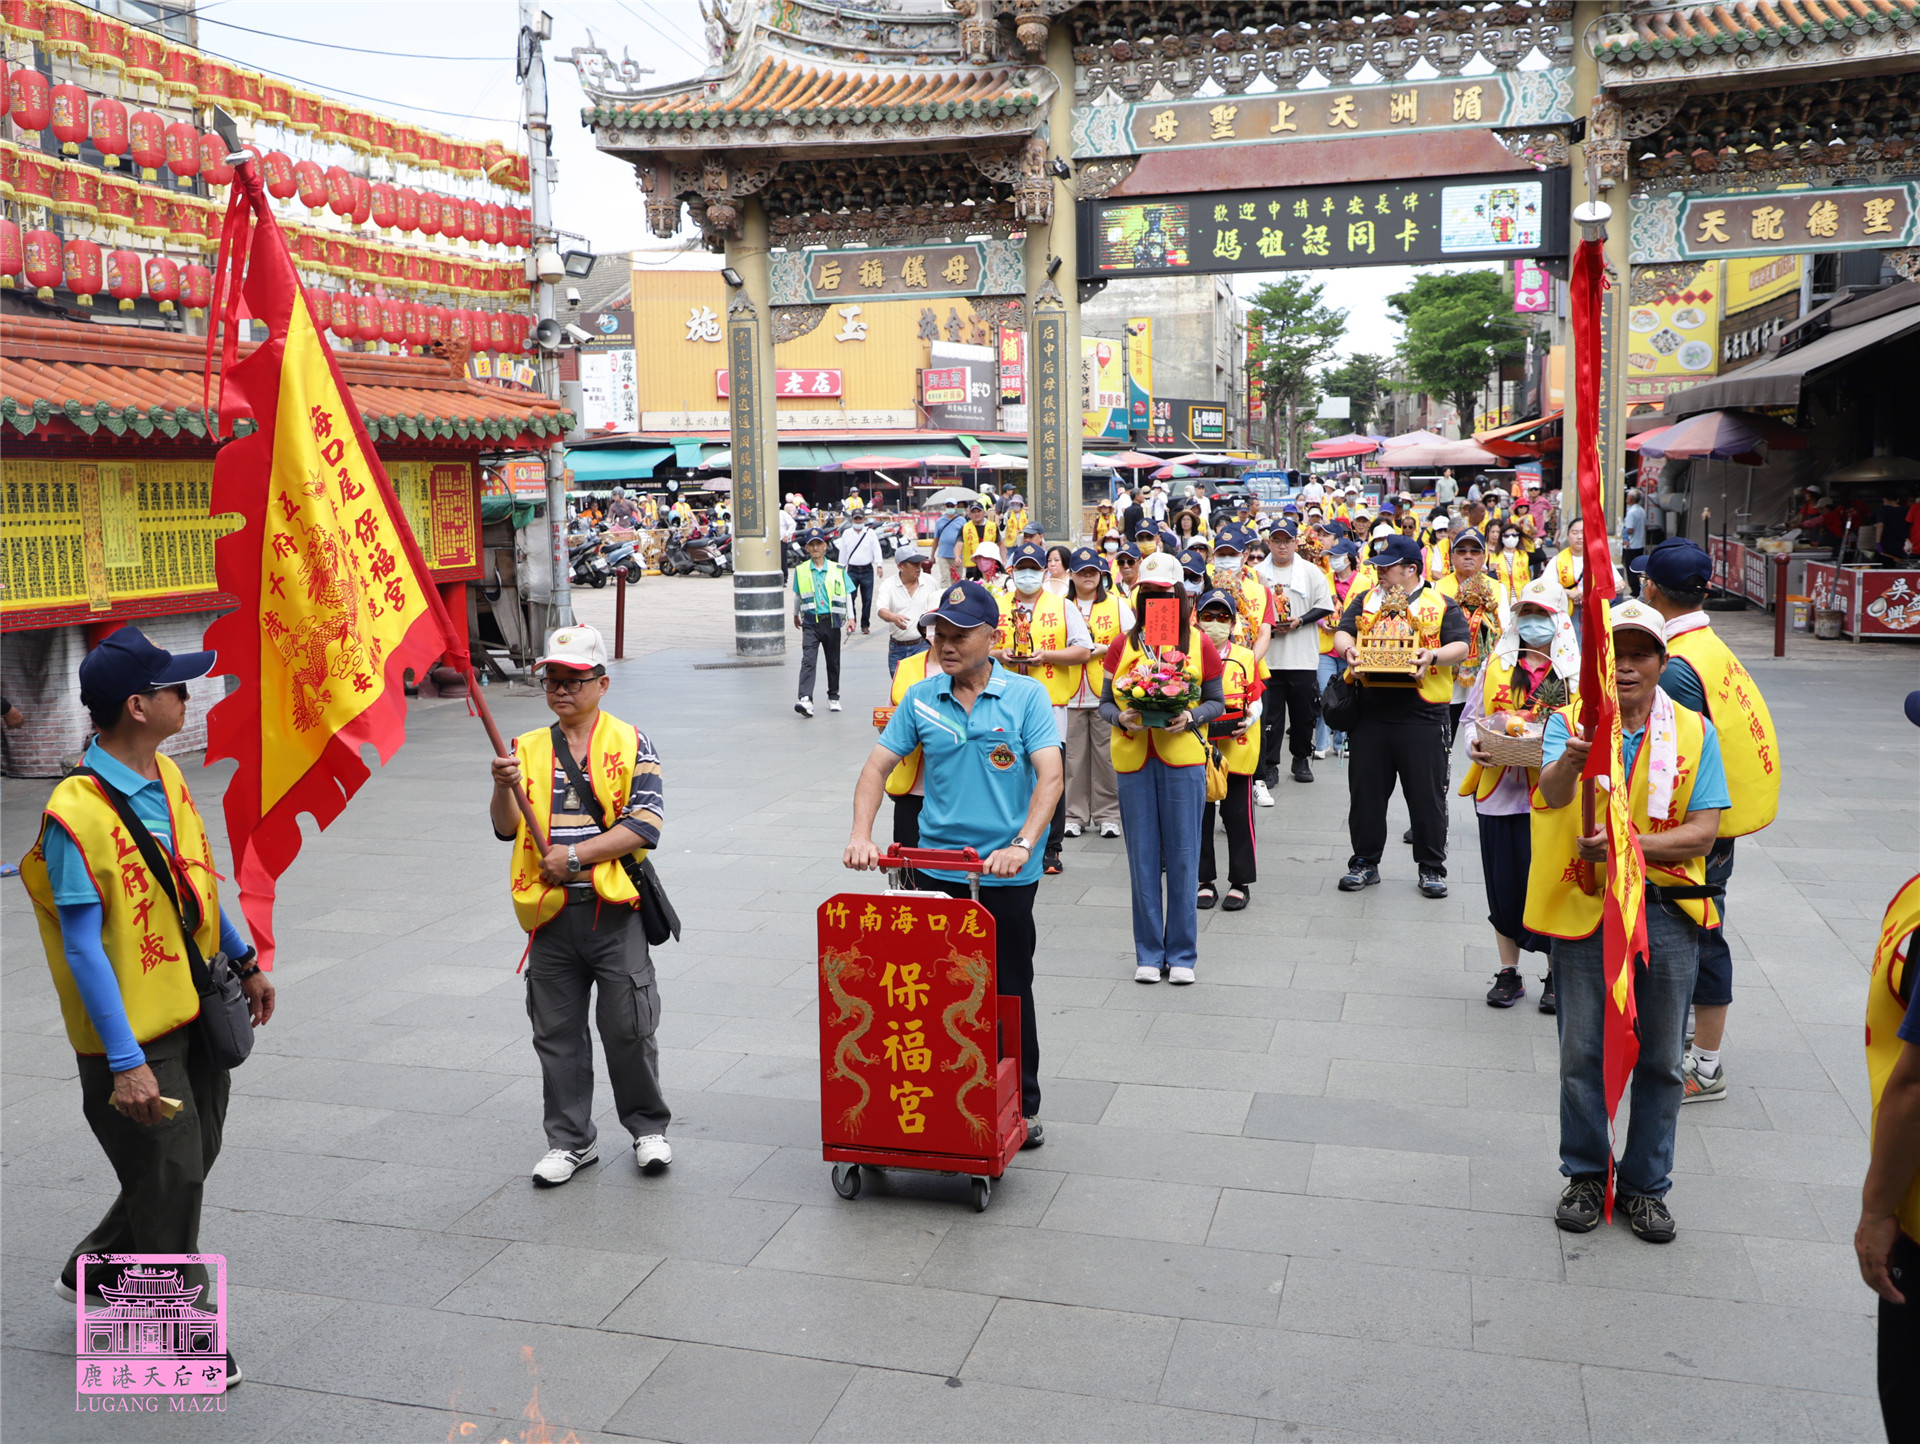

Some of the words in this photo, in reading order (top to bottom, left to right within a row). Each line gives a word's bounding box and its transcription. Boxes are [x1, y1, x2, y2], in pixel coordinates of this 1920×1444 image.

[1214, 192, 1420, 222] 歡迎申請平安長伴
[1696, 197, 1896, 244] 聖德配天
[1213, 218, 1421, 260] 媽祖認同卡
[815, 254, 970, 291] 母儀稱后
[685, 306, 723, 342] 施
[834, 305, 868, 342] 玉
[783, 371, 832, 394] 老店
[263, 490, 302, 641] 五府千歲
[111, 825, 181, 976] 五府千歲
[825, 901, 987, 938] 竹南海口尾
[878, 961, 934, 1135] 保福宮
